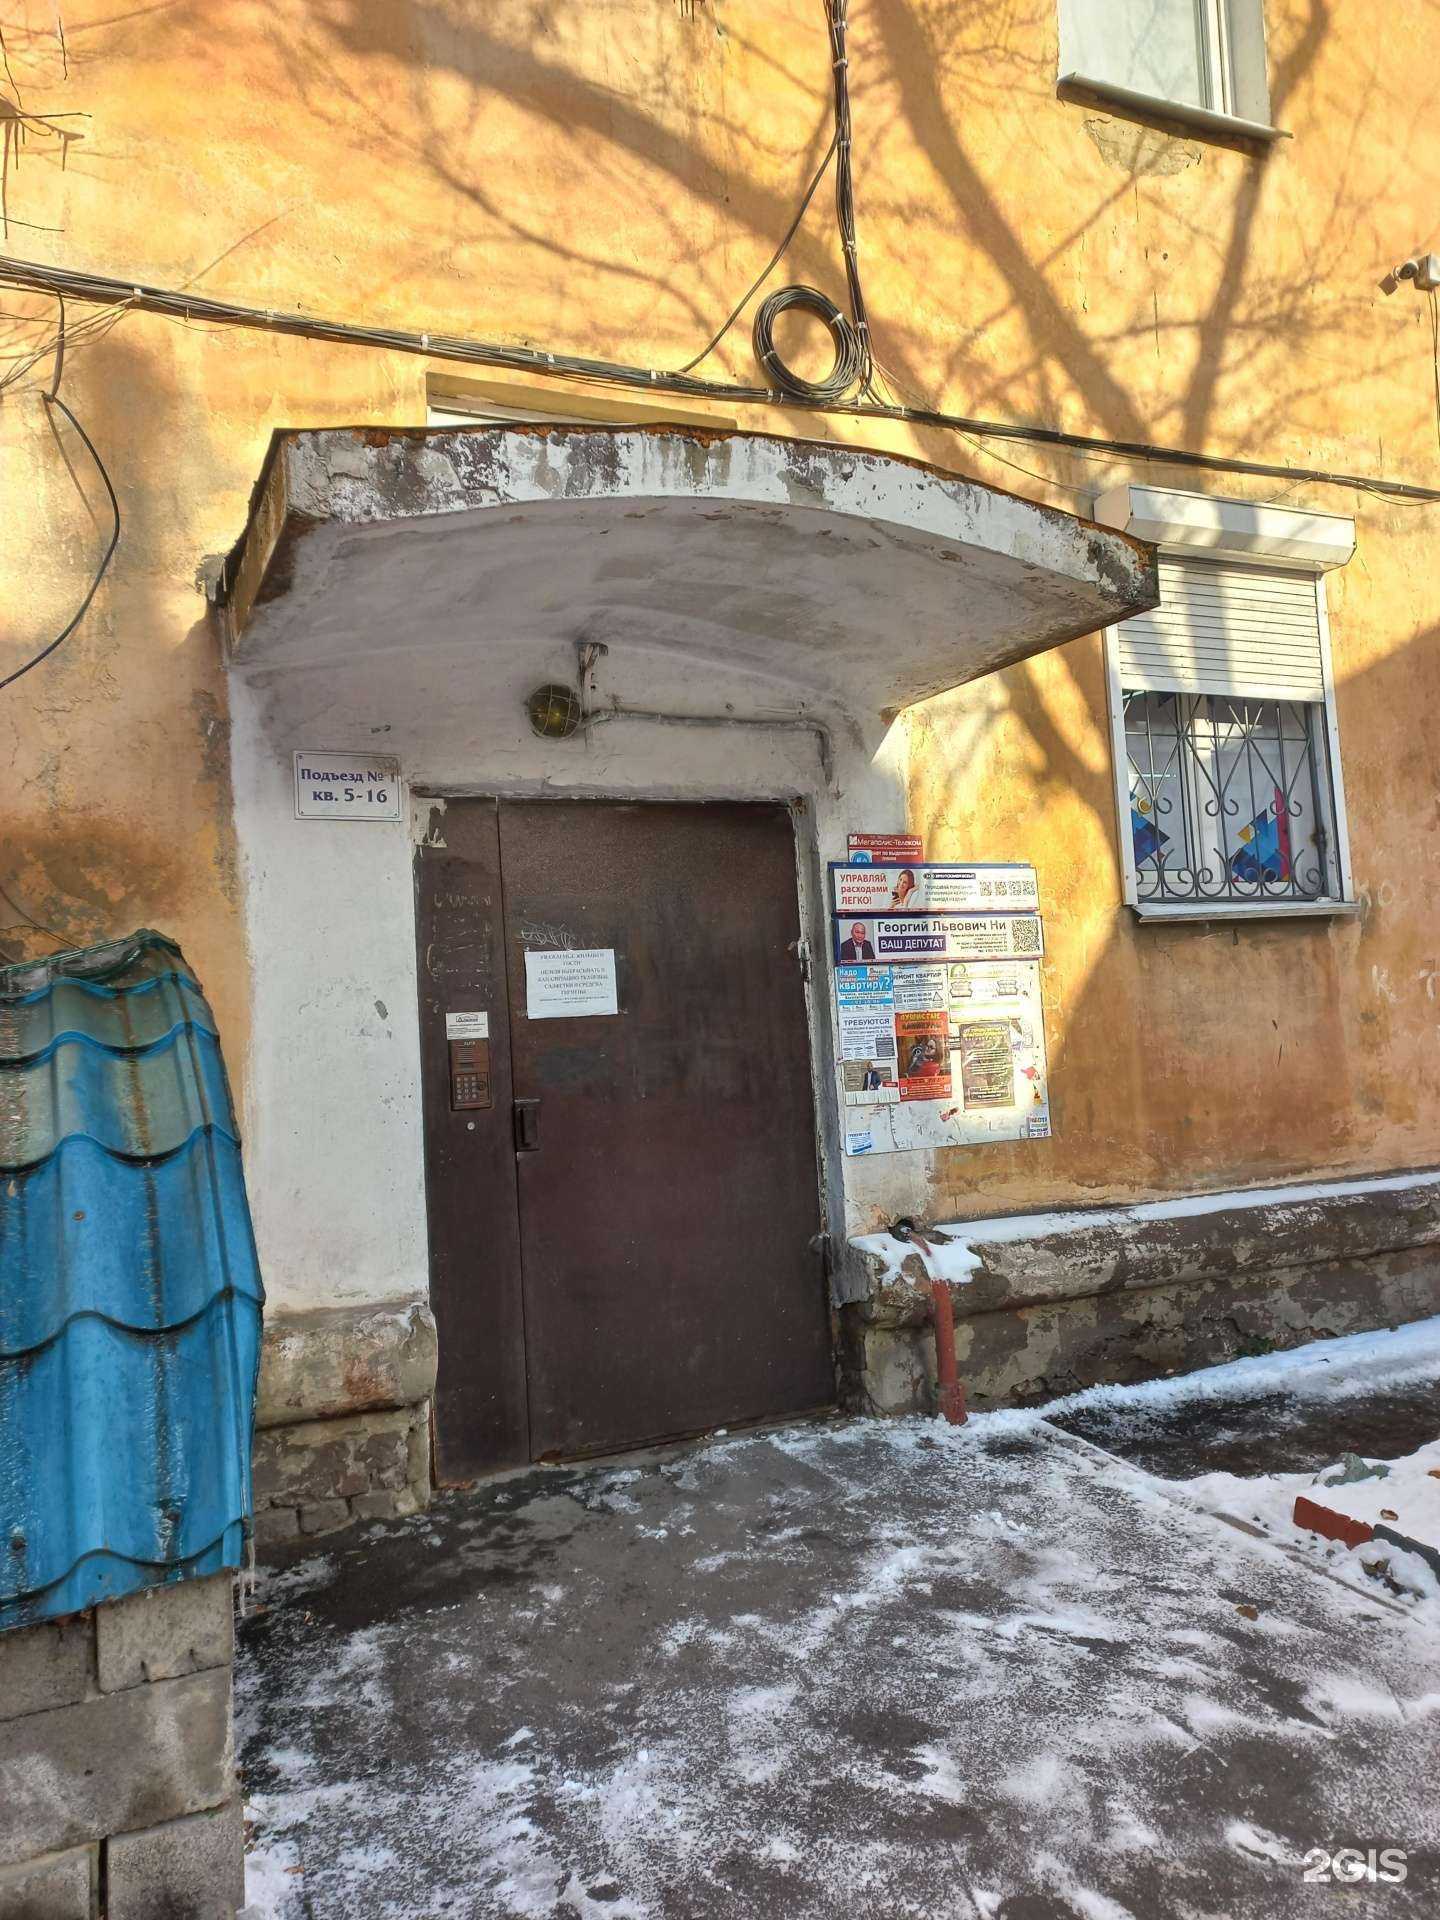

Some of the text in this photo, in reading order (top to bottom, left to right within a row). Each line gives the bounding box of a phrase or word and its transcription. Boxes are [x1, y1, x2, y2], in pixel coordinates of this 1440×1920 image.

[301, 768, 364, 783] Подъезд
[367, 771, 384, 782] №
[312, 788, 388, 803] кв. 5-16
[839, 873, 888, 883] УПРАВЛЯЙ
[840, 885, 888, 895] расходами
[841, 896, 872, 905] ЛЕГКО!
[878, 920, 1006, 934] Георгий Львович Ни
[881, 939, 904, 949] ВАШ
[905, 938, 944, 949] ДЕПУТАТ
[839, 968, 858, 976] Надо
[839, 977, 890, 991] квартиру?
[844, 1018, 890, 1027] ТРЕБУЮТСЯ
